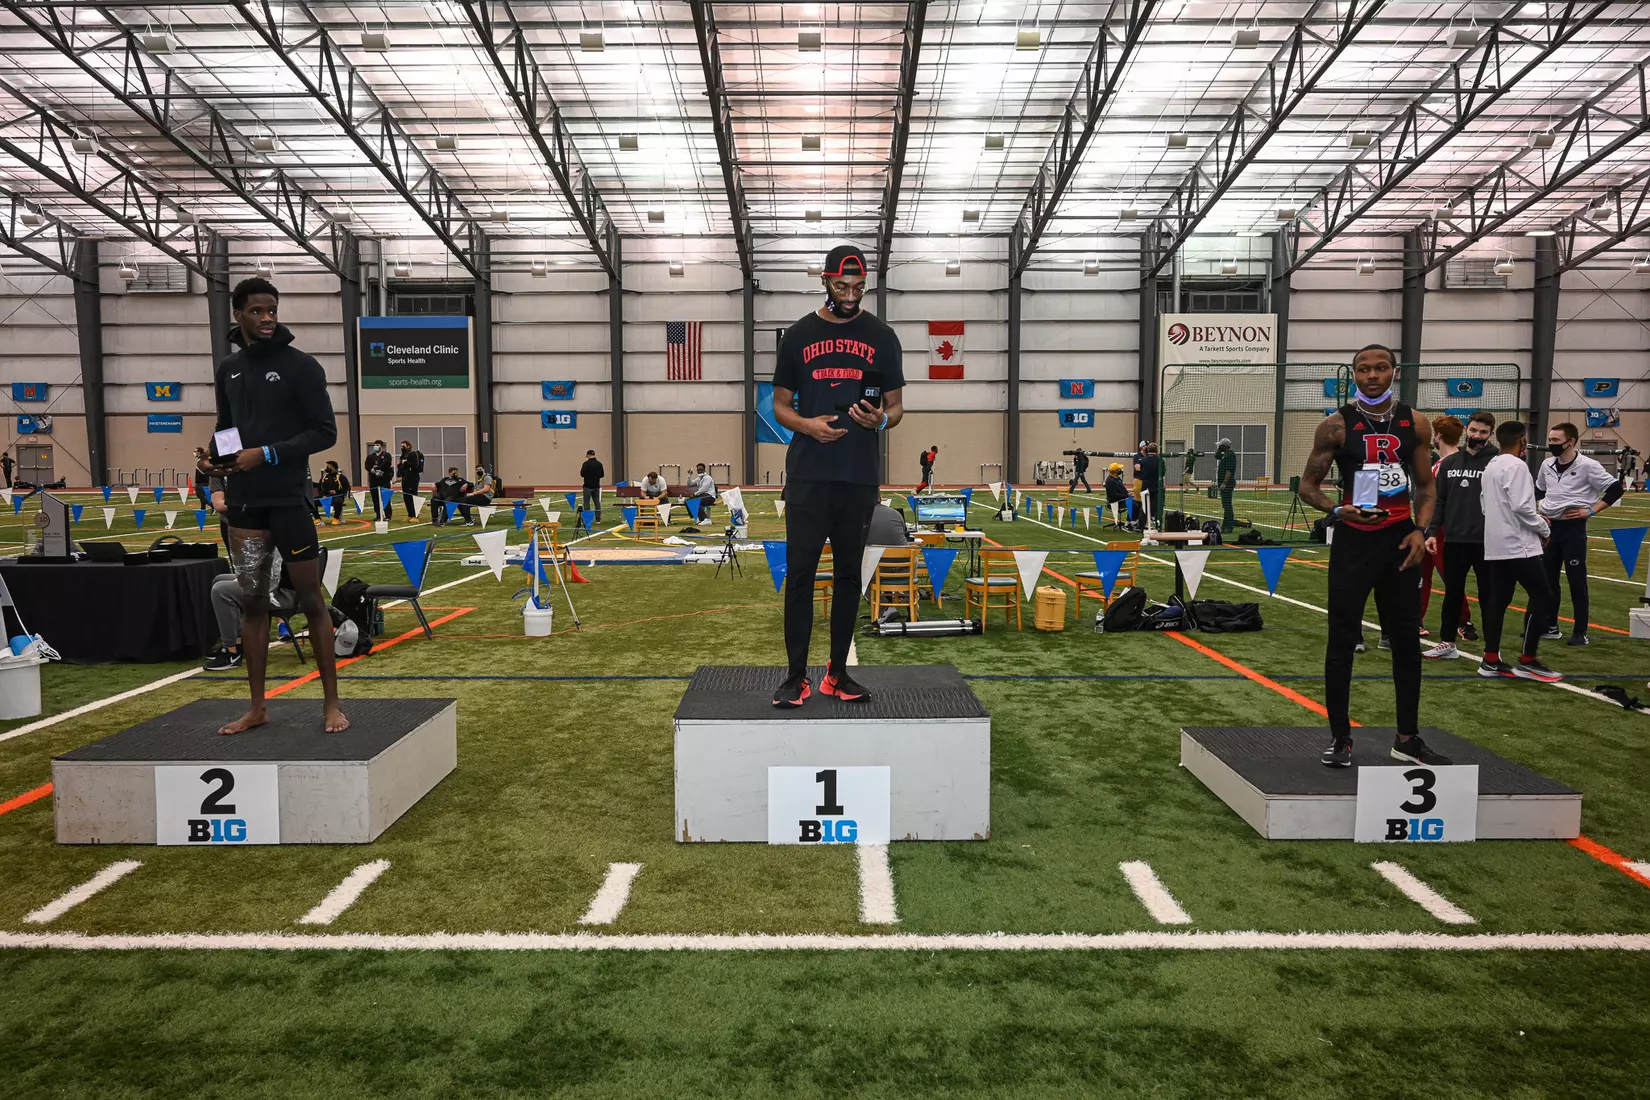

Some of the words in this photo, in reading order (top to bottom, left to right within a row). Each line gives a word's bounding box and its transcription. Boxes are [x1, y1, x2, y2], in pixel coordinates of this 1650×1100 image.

[1192, 326, 1271, 343] BEYNON
[386, 345, 432, 354] Cleveland
[433, 345, 459, 354] Clinic
[803, 339, 834, 364] OHIO
[836, 338, 876, 365] STATE
[1205, 345, 1225, 353] Tarkett
[1225, 345, 1244, 353] Sports
[1245, 345, 1270, 353] Company
[816, 369, 835, 378] TRACK
[837, 369, 841, 378] &
[842, 369, 860, 379] FIELD
[388, 378, 443, 387] sports-health.org
[1071, 381, 1084, 395] N
[1593, 382, 1612, 393] P
[155, 385, 171, 397] M
[1363, 433, 1401, 465] R
[1447, 469, 1485, 478] EQUALIT
[199, 767, 236, 815] 2
[815, 769, 844, 816] 1
[1399, 768, 1437, 815] 3
